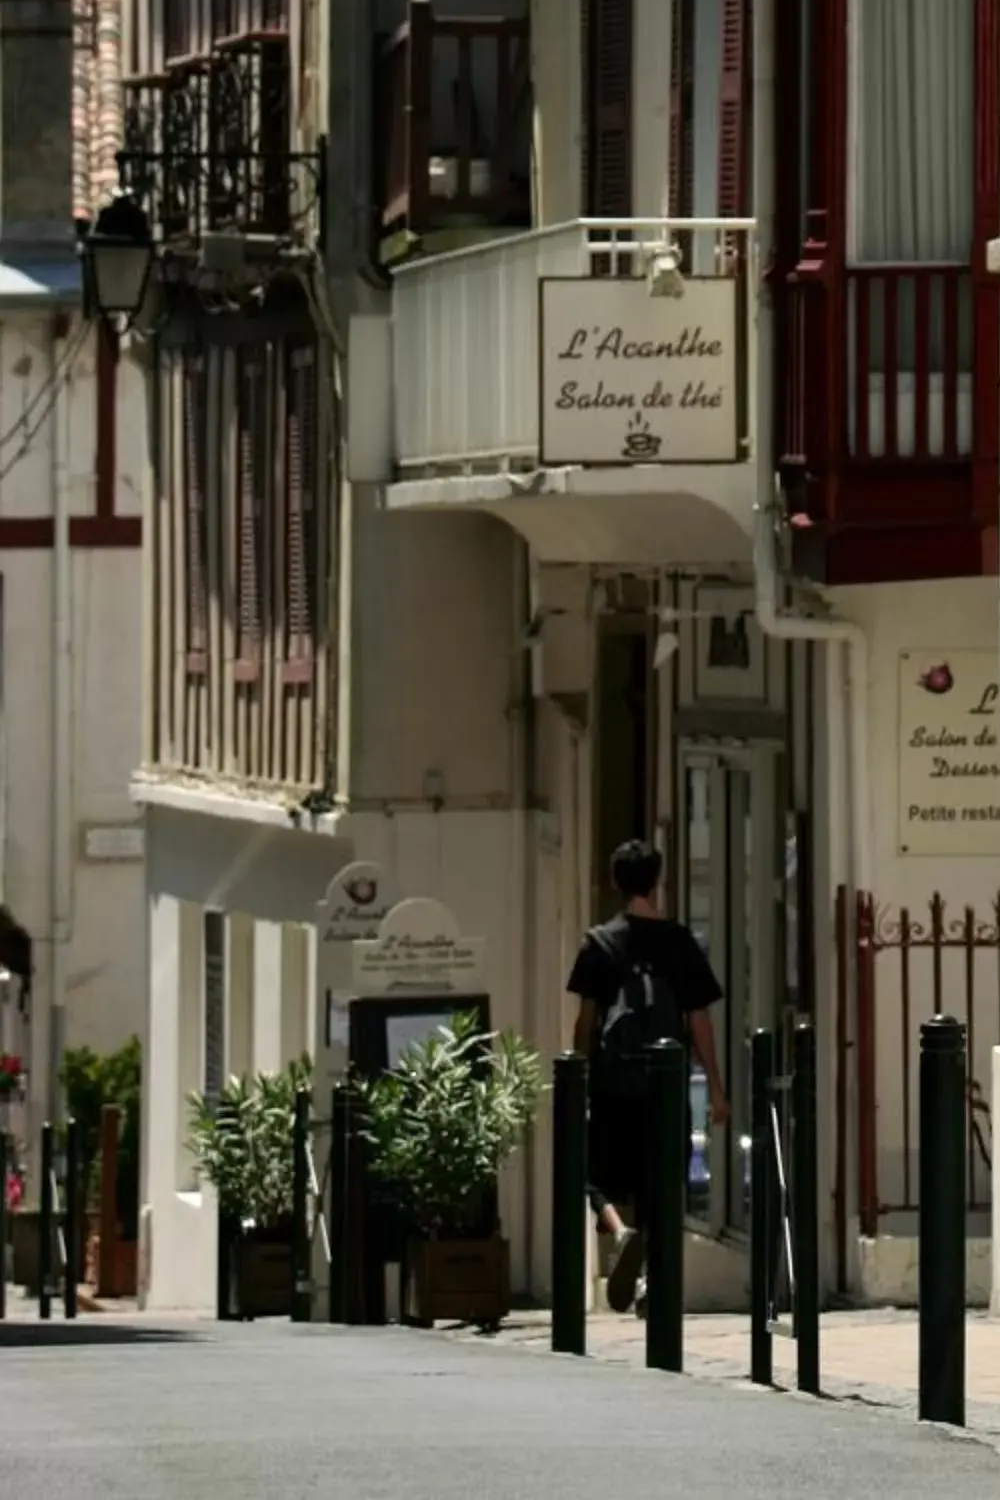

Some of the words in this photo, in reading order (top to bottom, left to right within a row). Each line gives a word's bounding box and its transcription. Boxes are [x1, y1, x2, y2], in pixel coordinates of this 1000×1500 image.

[557, 325, 723, 359] L'Acanthe
[555, 380, 635, 410] Salon
[641, 379, 673, 409] de
[678, 380, 723, 409] thé
[909, 725, 968, 748] Salon
[973, 724, 998, 747] de
[908, 803, 957, 822] Petite
